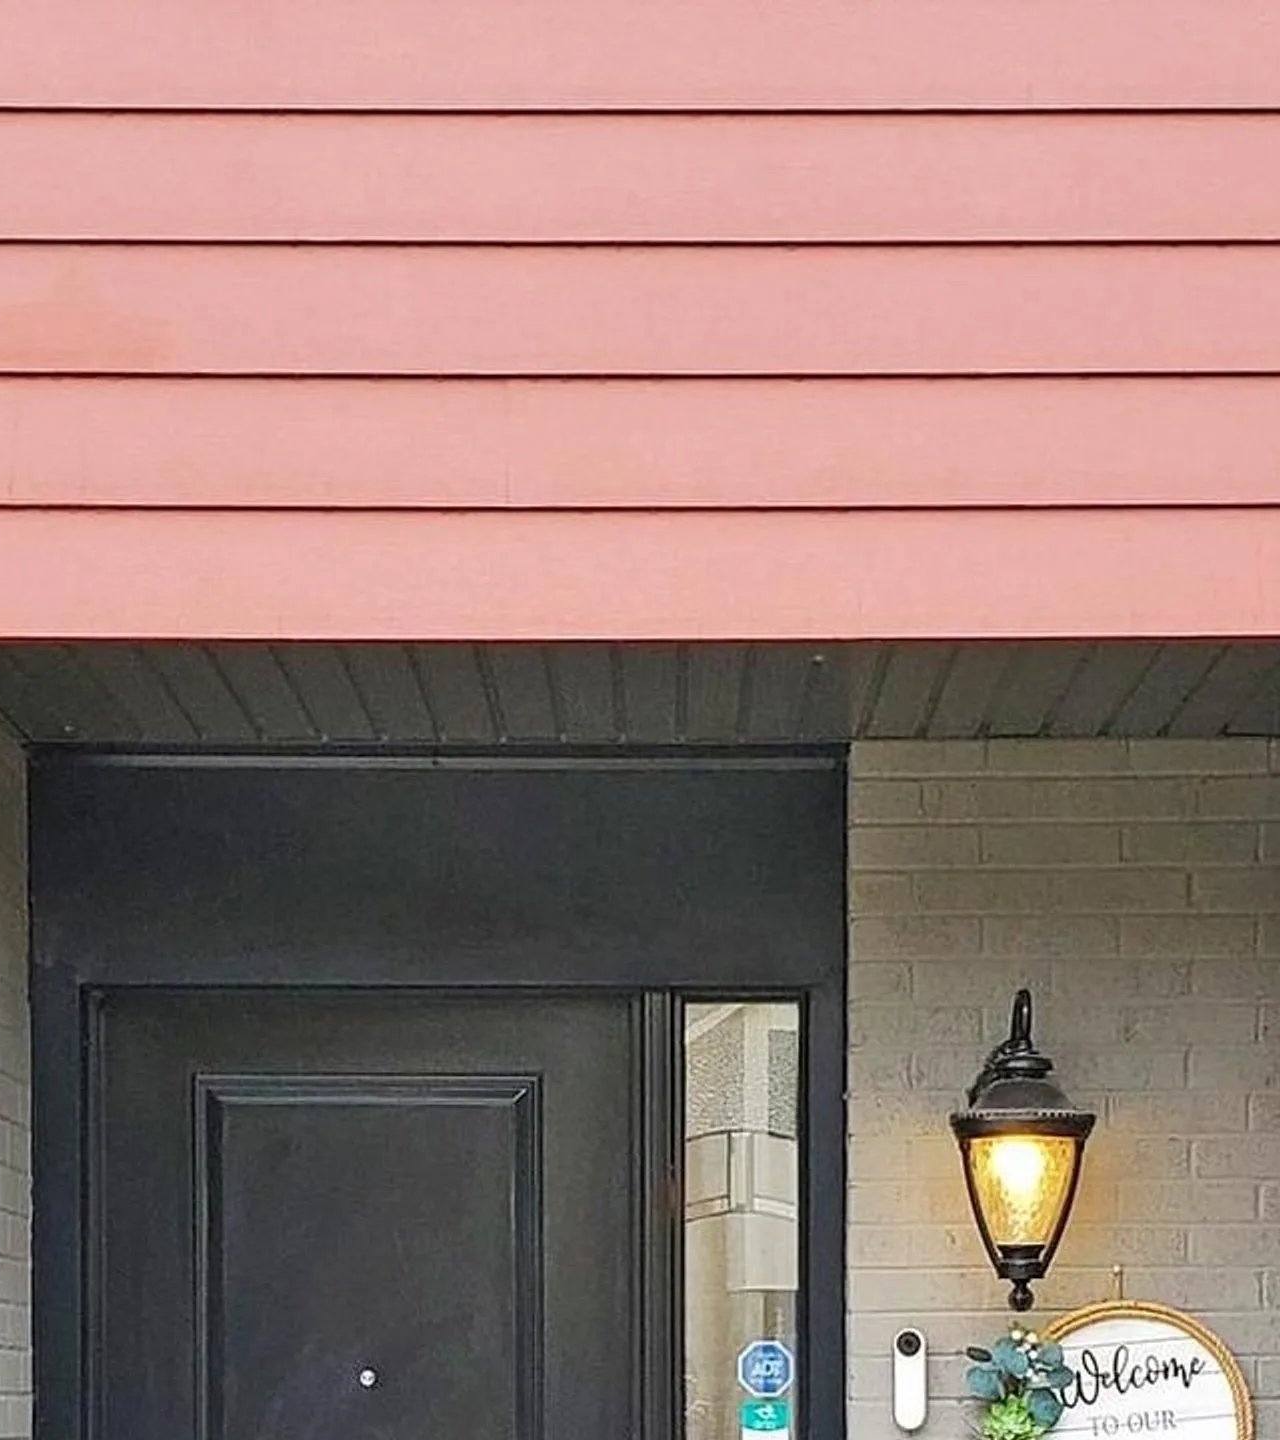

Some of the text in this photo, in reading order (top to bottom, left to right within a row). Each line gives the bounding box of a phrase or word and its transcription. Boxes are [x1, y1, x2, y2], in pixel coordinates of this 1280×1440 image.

[1060, 1345, 1206, 1409] Welcome
[1088, 1409, 1177, 1437] TO OUR
